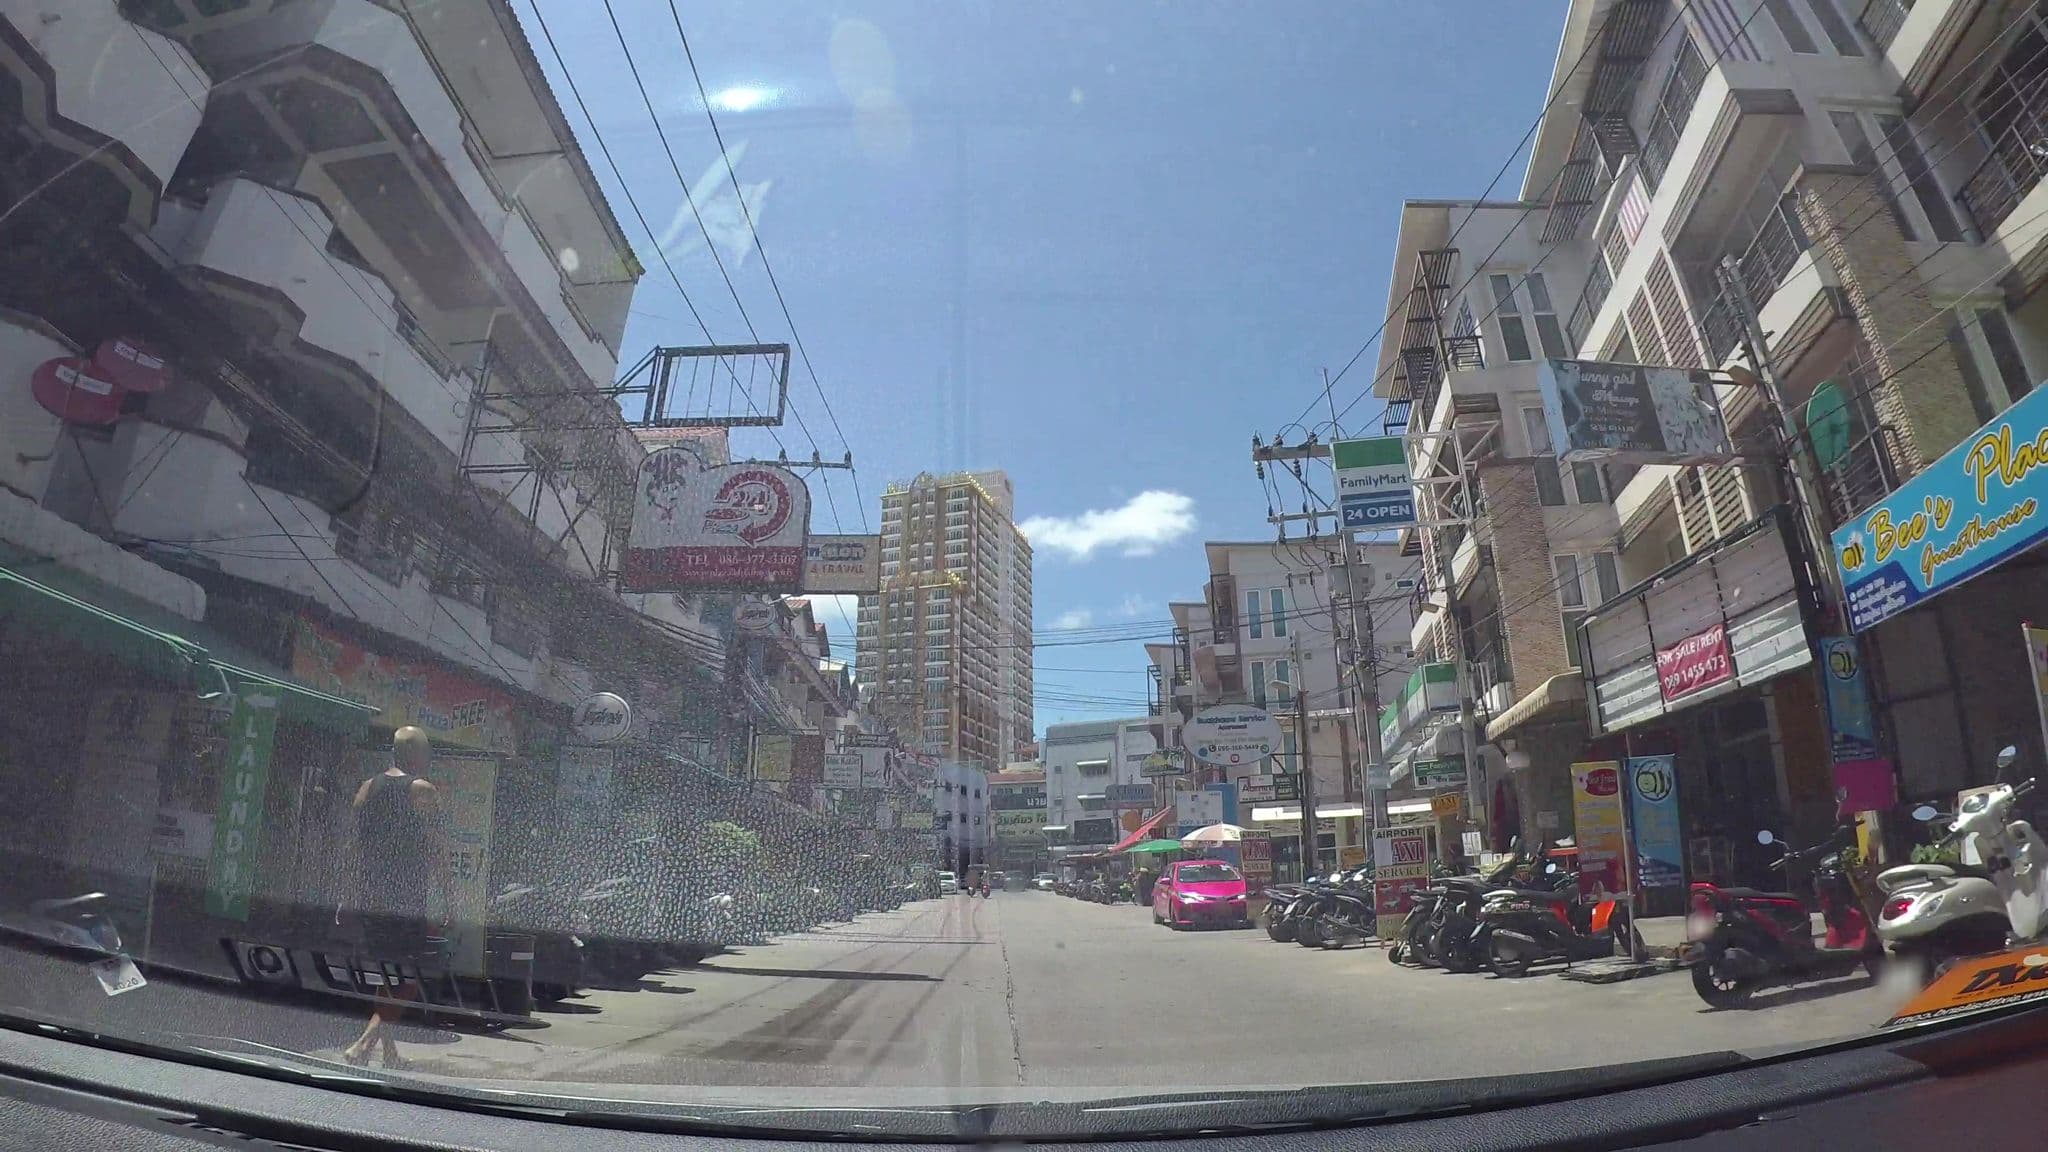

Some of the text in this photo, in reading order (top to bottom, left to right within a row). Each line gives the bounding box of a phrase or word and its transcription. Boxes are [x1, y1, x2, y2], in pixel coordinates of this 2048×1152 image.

[1340, 473, 1408, 488] FamilyMart
[1346, 504, 1411, 521] 24 OPEN
[1867, 497, 1952, 562] Bee's
[1921, 499, 2036, 587] Guesthouse
[1657, 650, 1674, 668] FOR
[1375, 827, 1420, 840] AIRPORT
[1378, 866, 1423, 879] SERVICE
